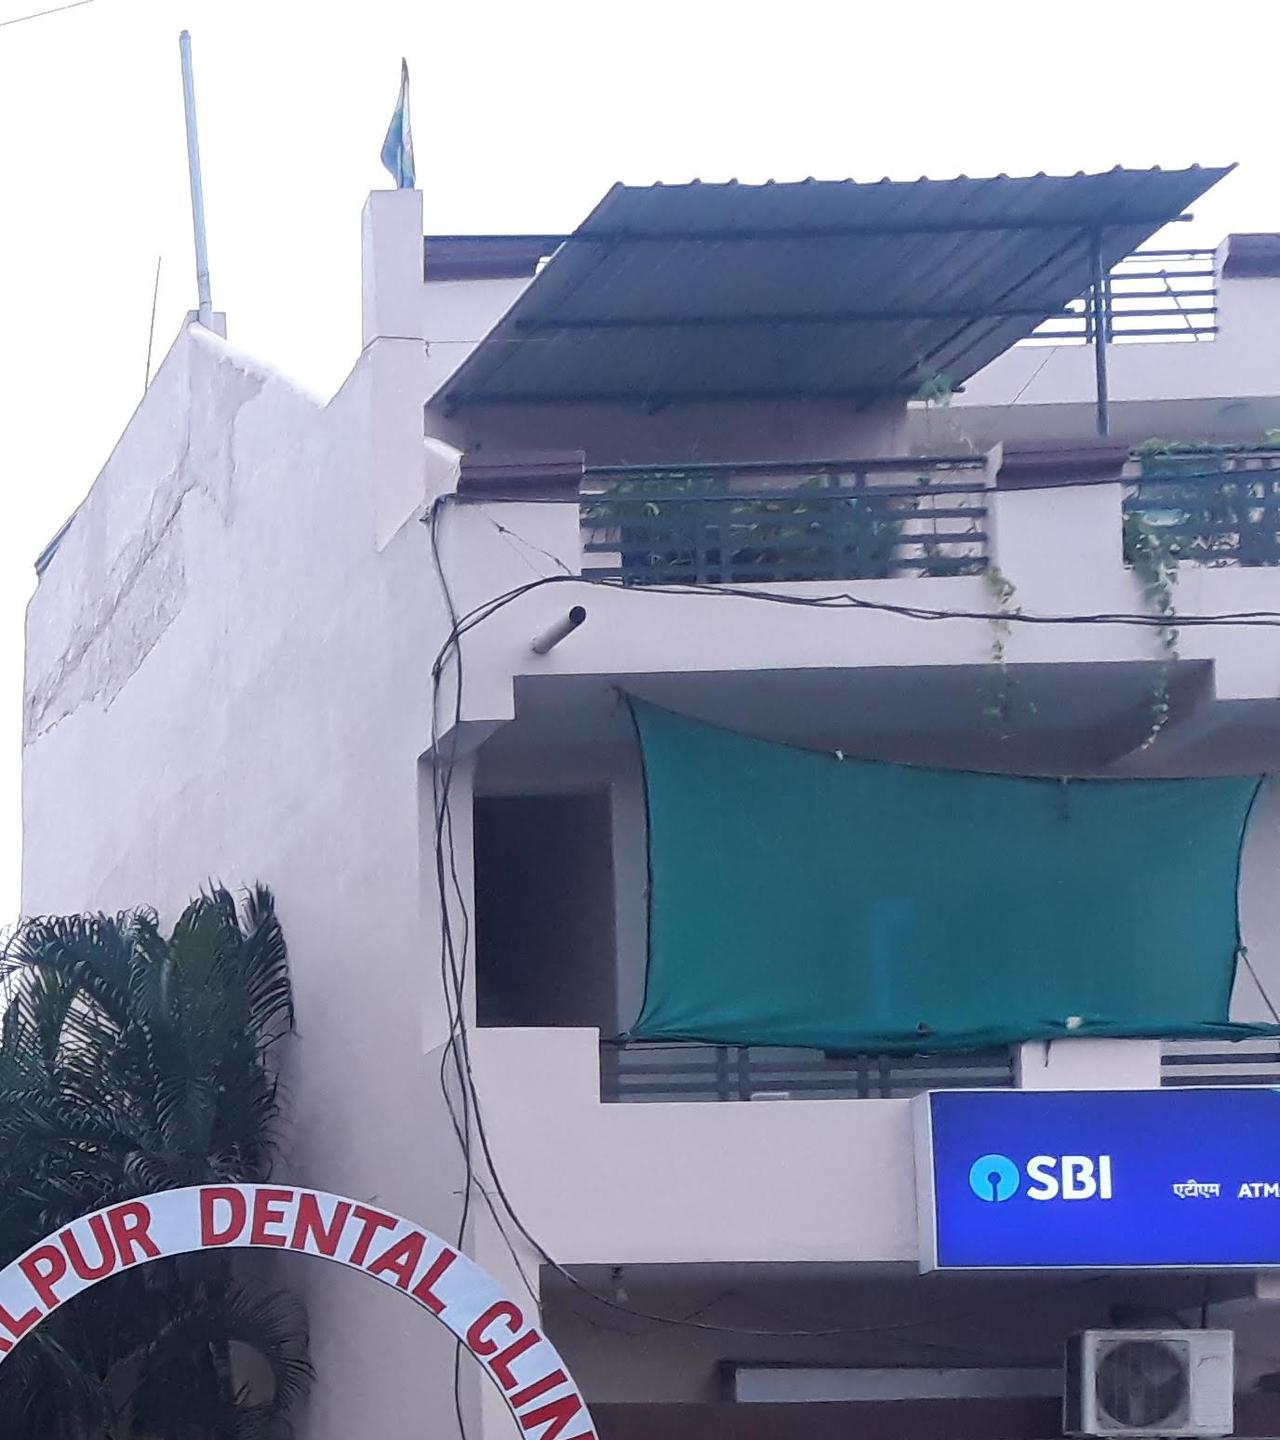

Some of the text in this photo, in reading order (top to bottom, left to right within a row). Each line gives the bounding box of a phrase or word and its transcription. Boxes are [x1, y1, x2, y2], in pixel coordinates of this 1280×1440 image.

[1026, 1154, 1112, 1200] SBI
[1172, 1179, 1220, 1198] एटीएम
[1238, 1182, 1280, 1198] ATM
[199, 1186, 457, 1315] DENTAL
